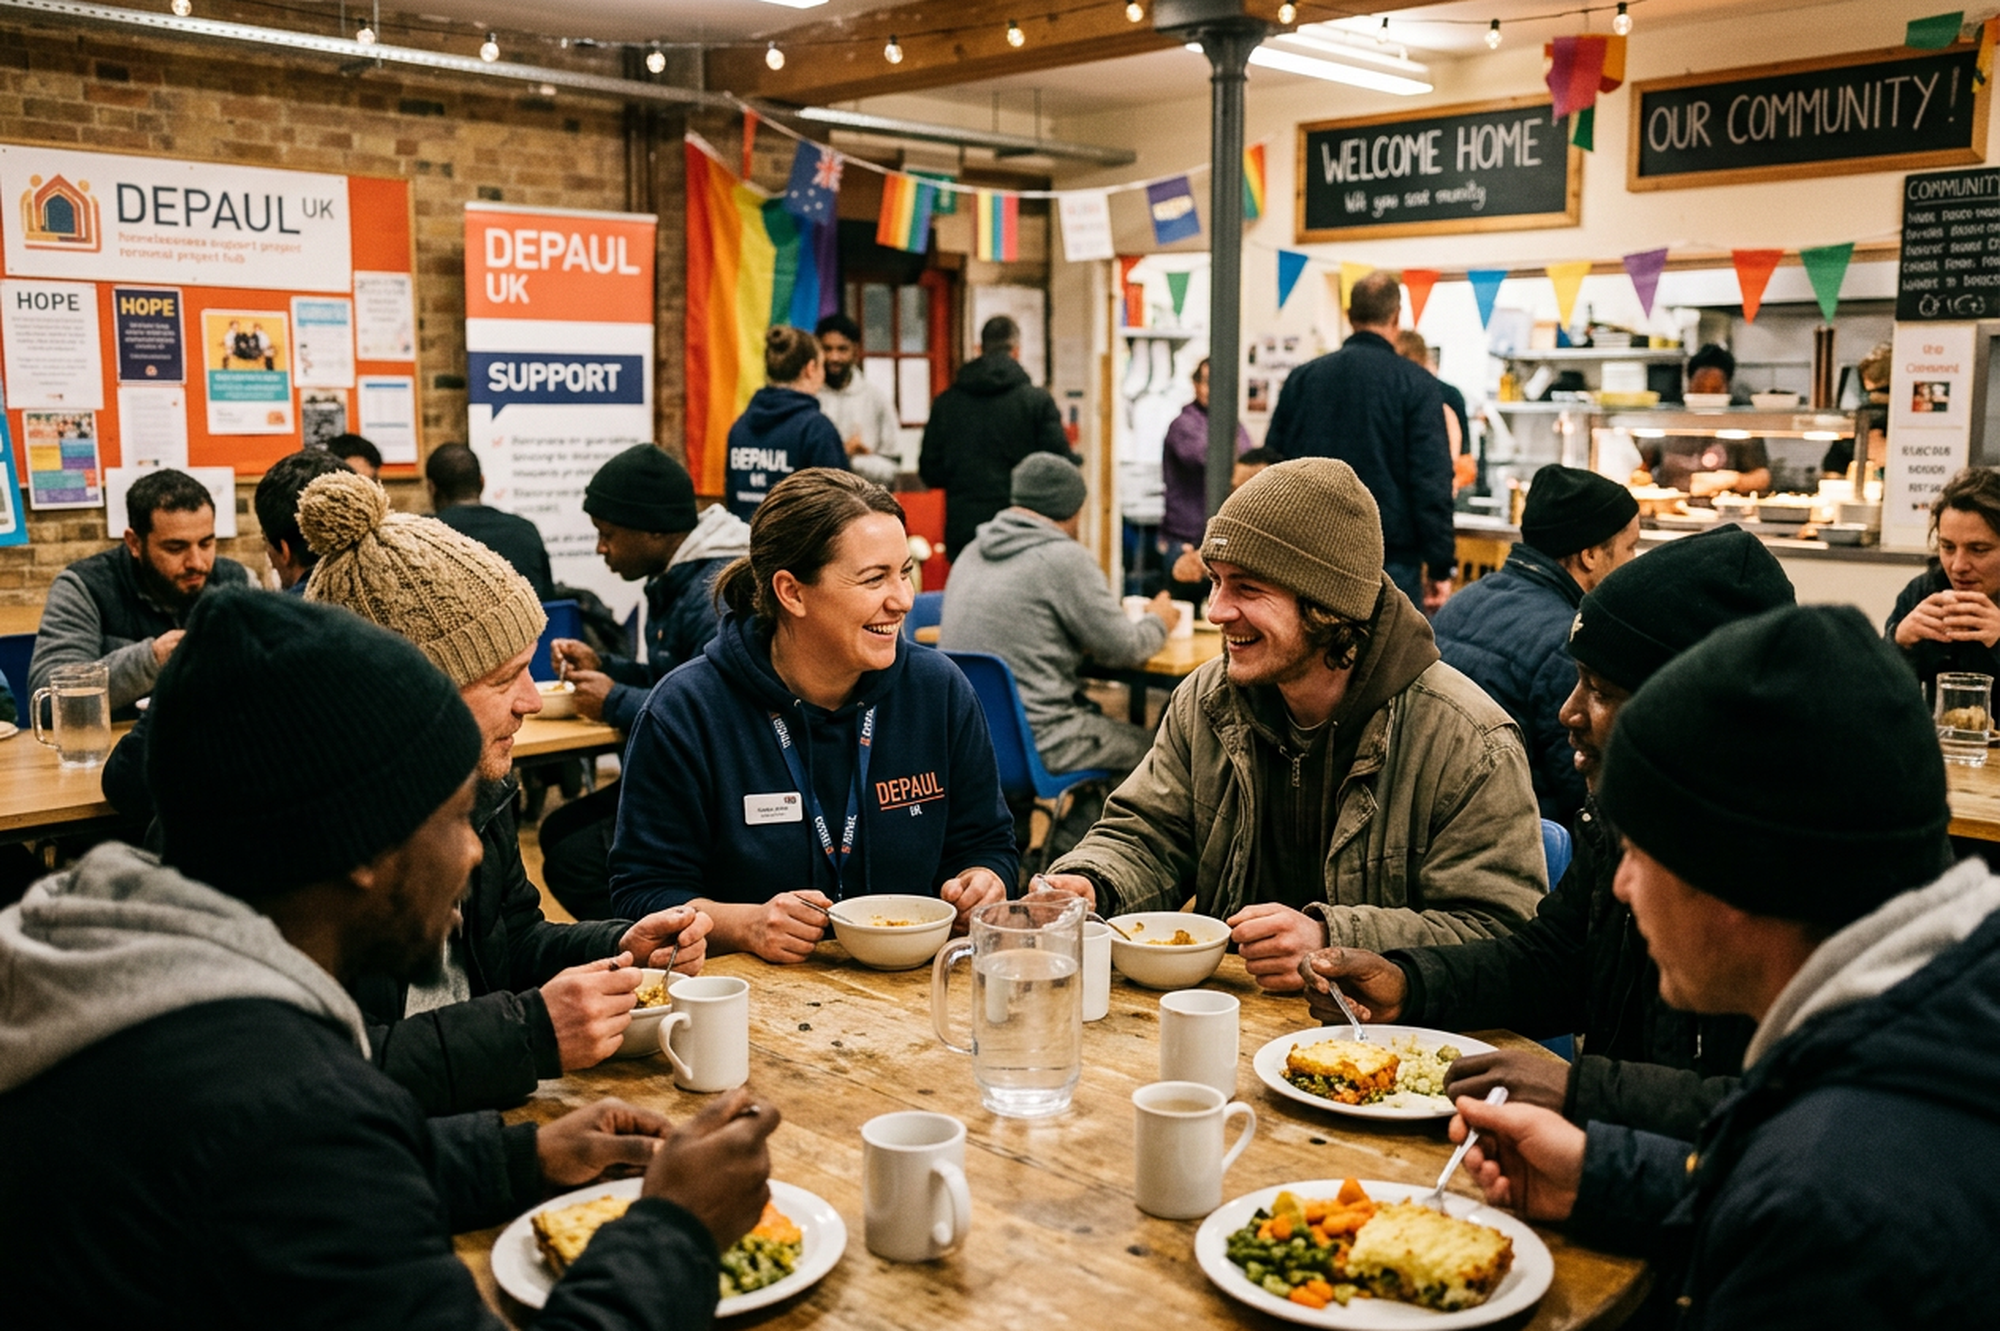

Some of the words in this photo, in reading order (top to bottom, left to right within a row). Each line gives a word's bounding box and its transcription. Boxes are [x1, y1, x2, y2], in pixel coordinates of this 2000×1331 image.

[1648, 101, 1712, 153] OUR
[1727, 71, 1941, 145] COMMUNITY
[1321, 129, 1444, 185] WELCOME
[1456, 118, 1543, 173] HOME
[116, 182, 301, 235] DEPAUL
[301, 197, 335, 220] UK
[485, 227, 642, 276] DEPAUL
[17, 291, 81, 312] HOPE
[486, 271, 531, 305] UK
[120, 297, 176, 317] HOPE
[488, 361, 623, 393] SUPPORT
[875, 771, 945, 805] DEPAUL
